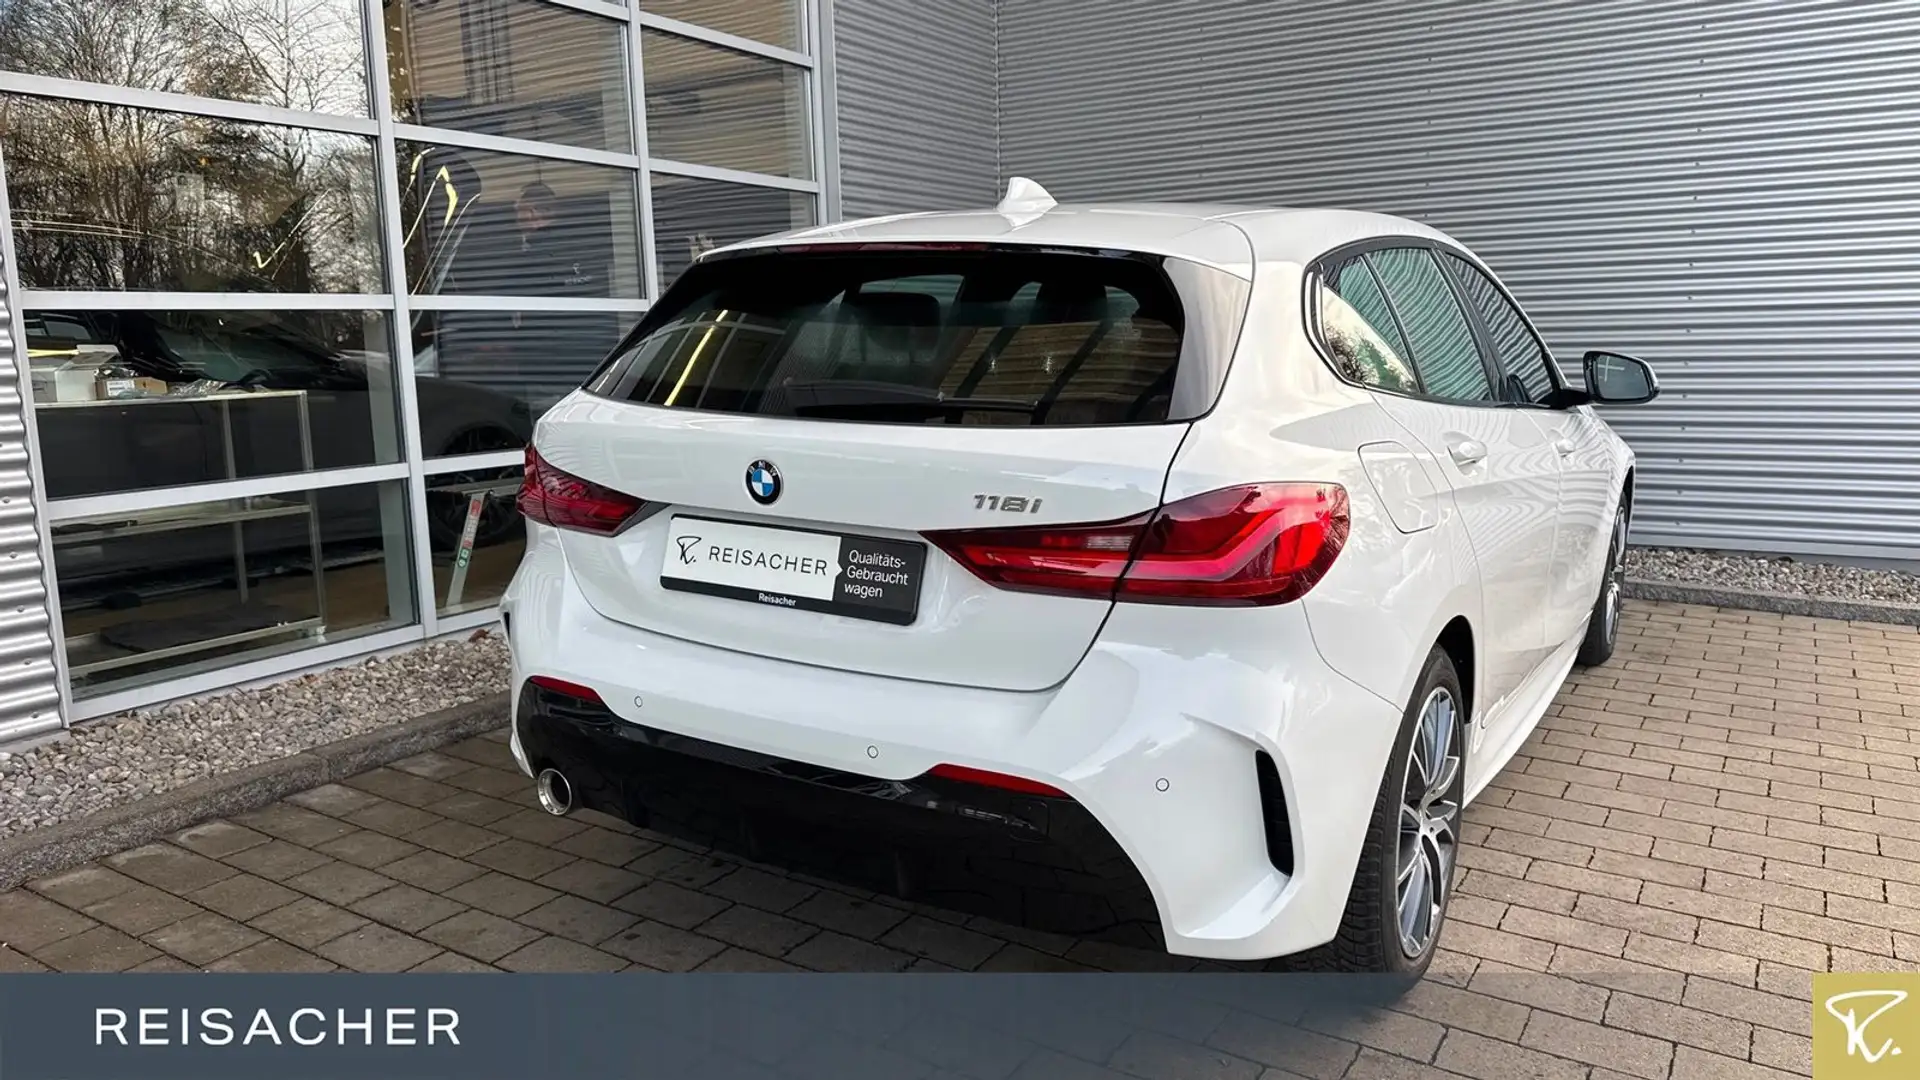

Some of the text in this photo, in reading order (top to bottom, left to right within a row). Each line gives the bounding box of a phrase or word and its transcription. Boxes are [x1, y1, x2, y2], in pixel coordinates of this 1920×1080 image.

[747, 460, 778, 477] BMW
[708, 546, 828, 576] REISACHER
[848, 549, 906, 569] Qualitäts-
[846, 565, 908, 585] Gebraucht
[758, 593, 797, 606] Reisacher
[844, 584, 883, 599] wagen
